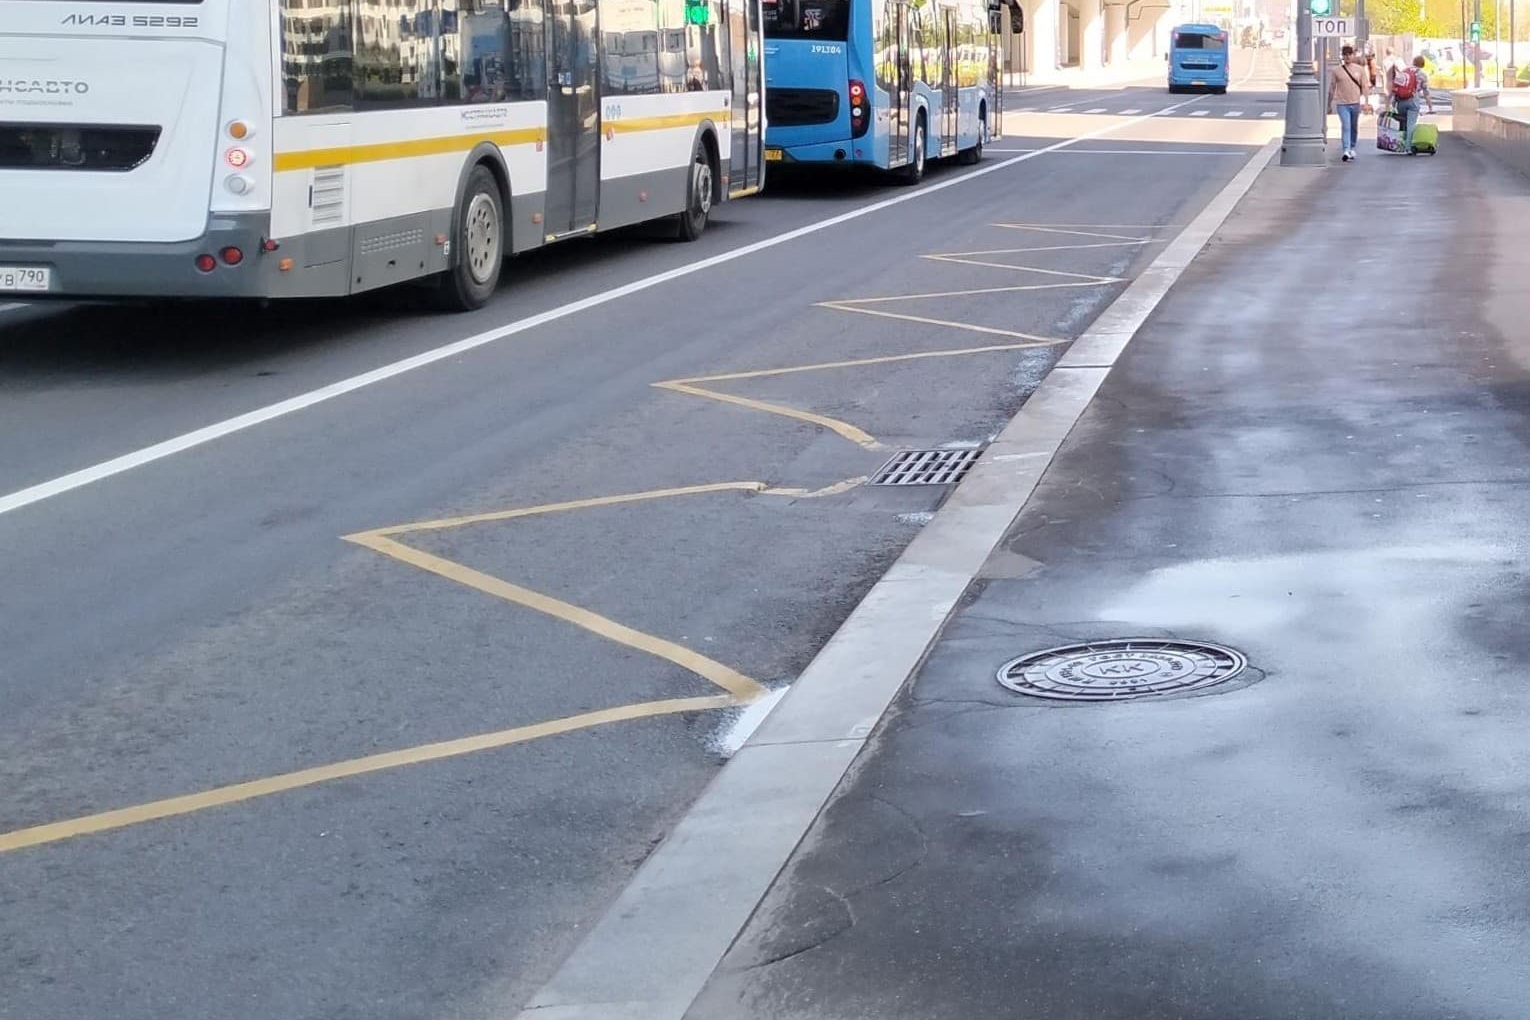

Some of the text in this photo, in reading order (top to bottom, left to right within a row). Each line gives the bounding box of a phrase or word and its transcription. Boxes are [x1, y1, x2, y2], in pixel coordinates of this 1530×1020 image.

[61, 13, 200, 28] ЛИАЗ 5292
[1315, 20, 1347, 34] ТОП
[19, 269, 44, 283] 790
